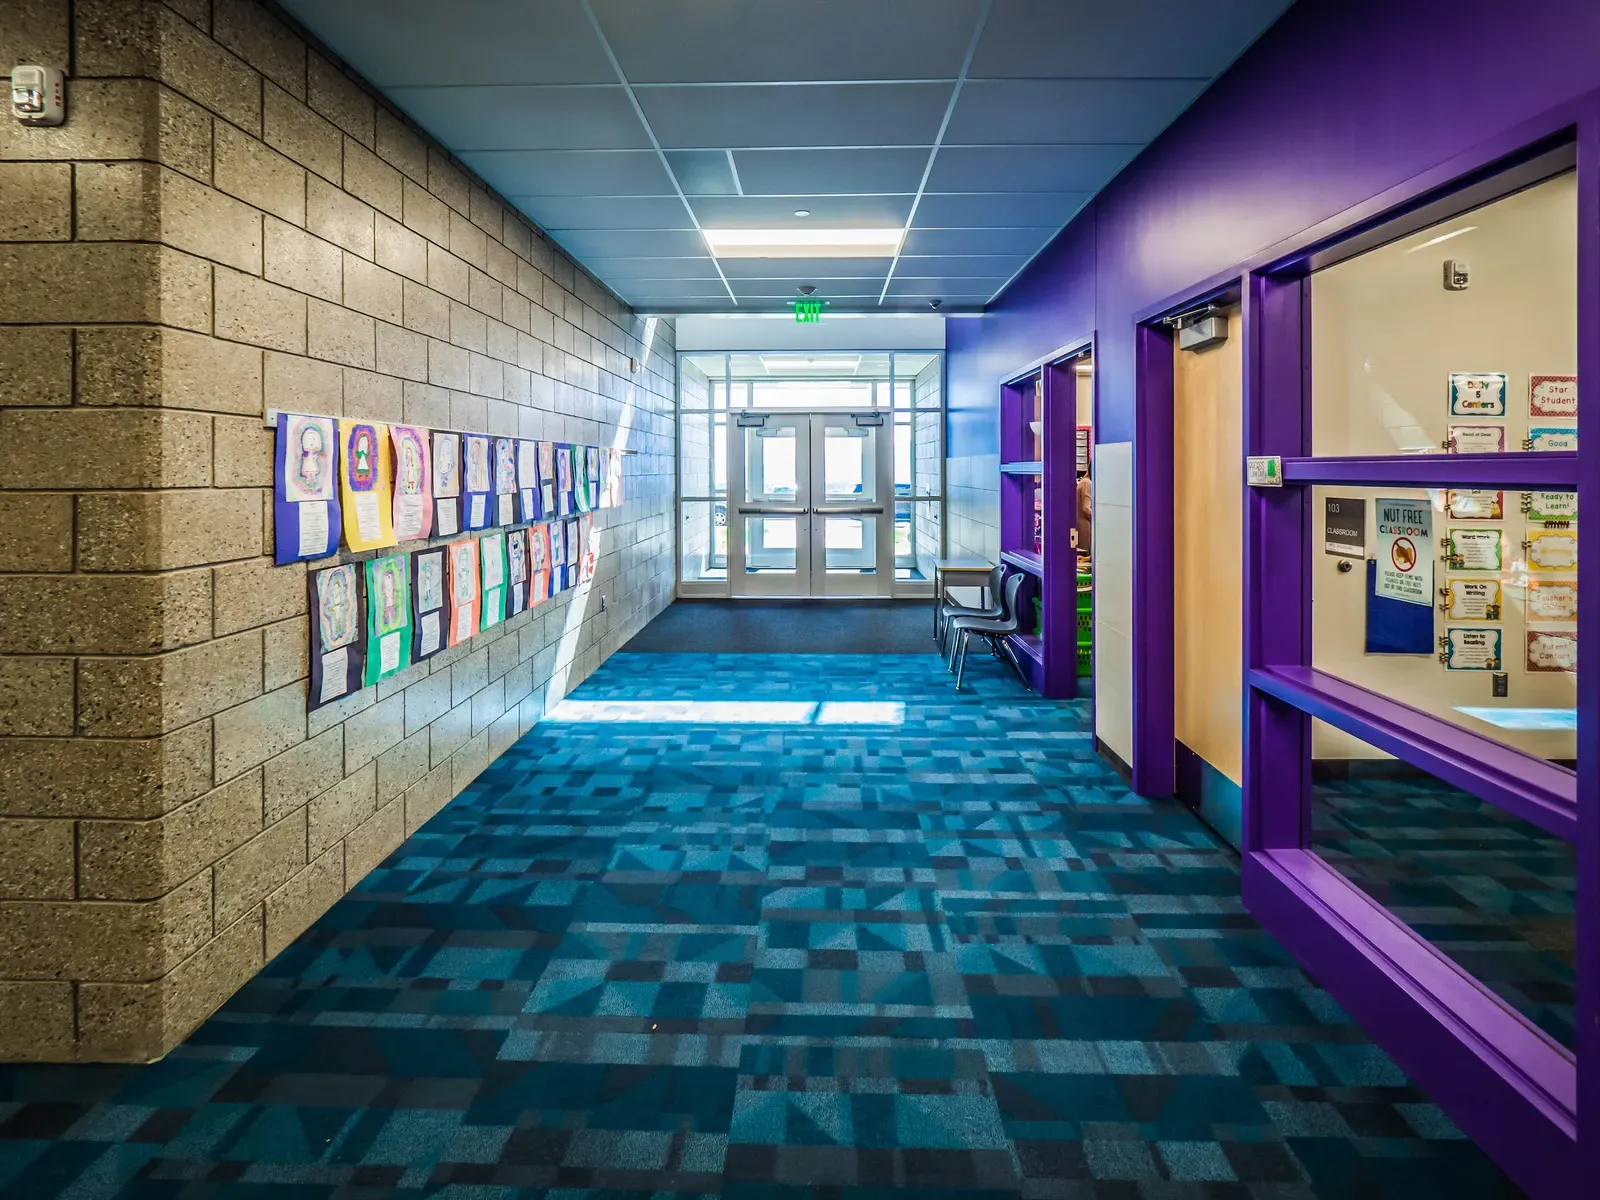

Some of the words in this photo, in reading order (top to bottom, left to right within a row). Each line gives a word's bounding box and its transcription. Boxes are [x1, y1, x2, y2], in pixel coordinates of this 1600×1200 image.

[795, 303, 821, 323] EXIT
[1462, 401, 1495, 409] Centers
[1541, 397, 1576, 405] Student
[1541, 493, 1563, 501] Ready
[1327, 503, 1340, 513] 103
[1384, 508, 1400, 522] NUT
[1402, 509, 1423, 524] FREE
[1327, 528, 1358, 537] CLASSROOM
[1380, 525, 1428, 537] CLASSROOM
